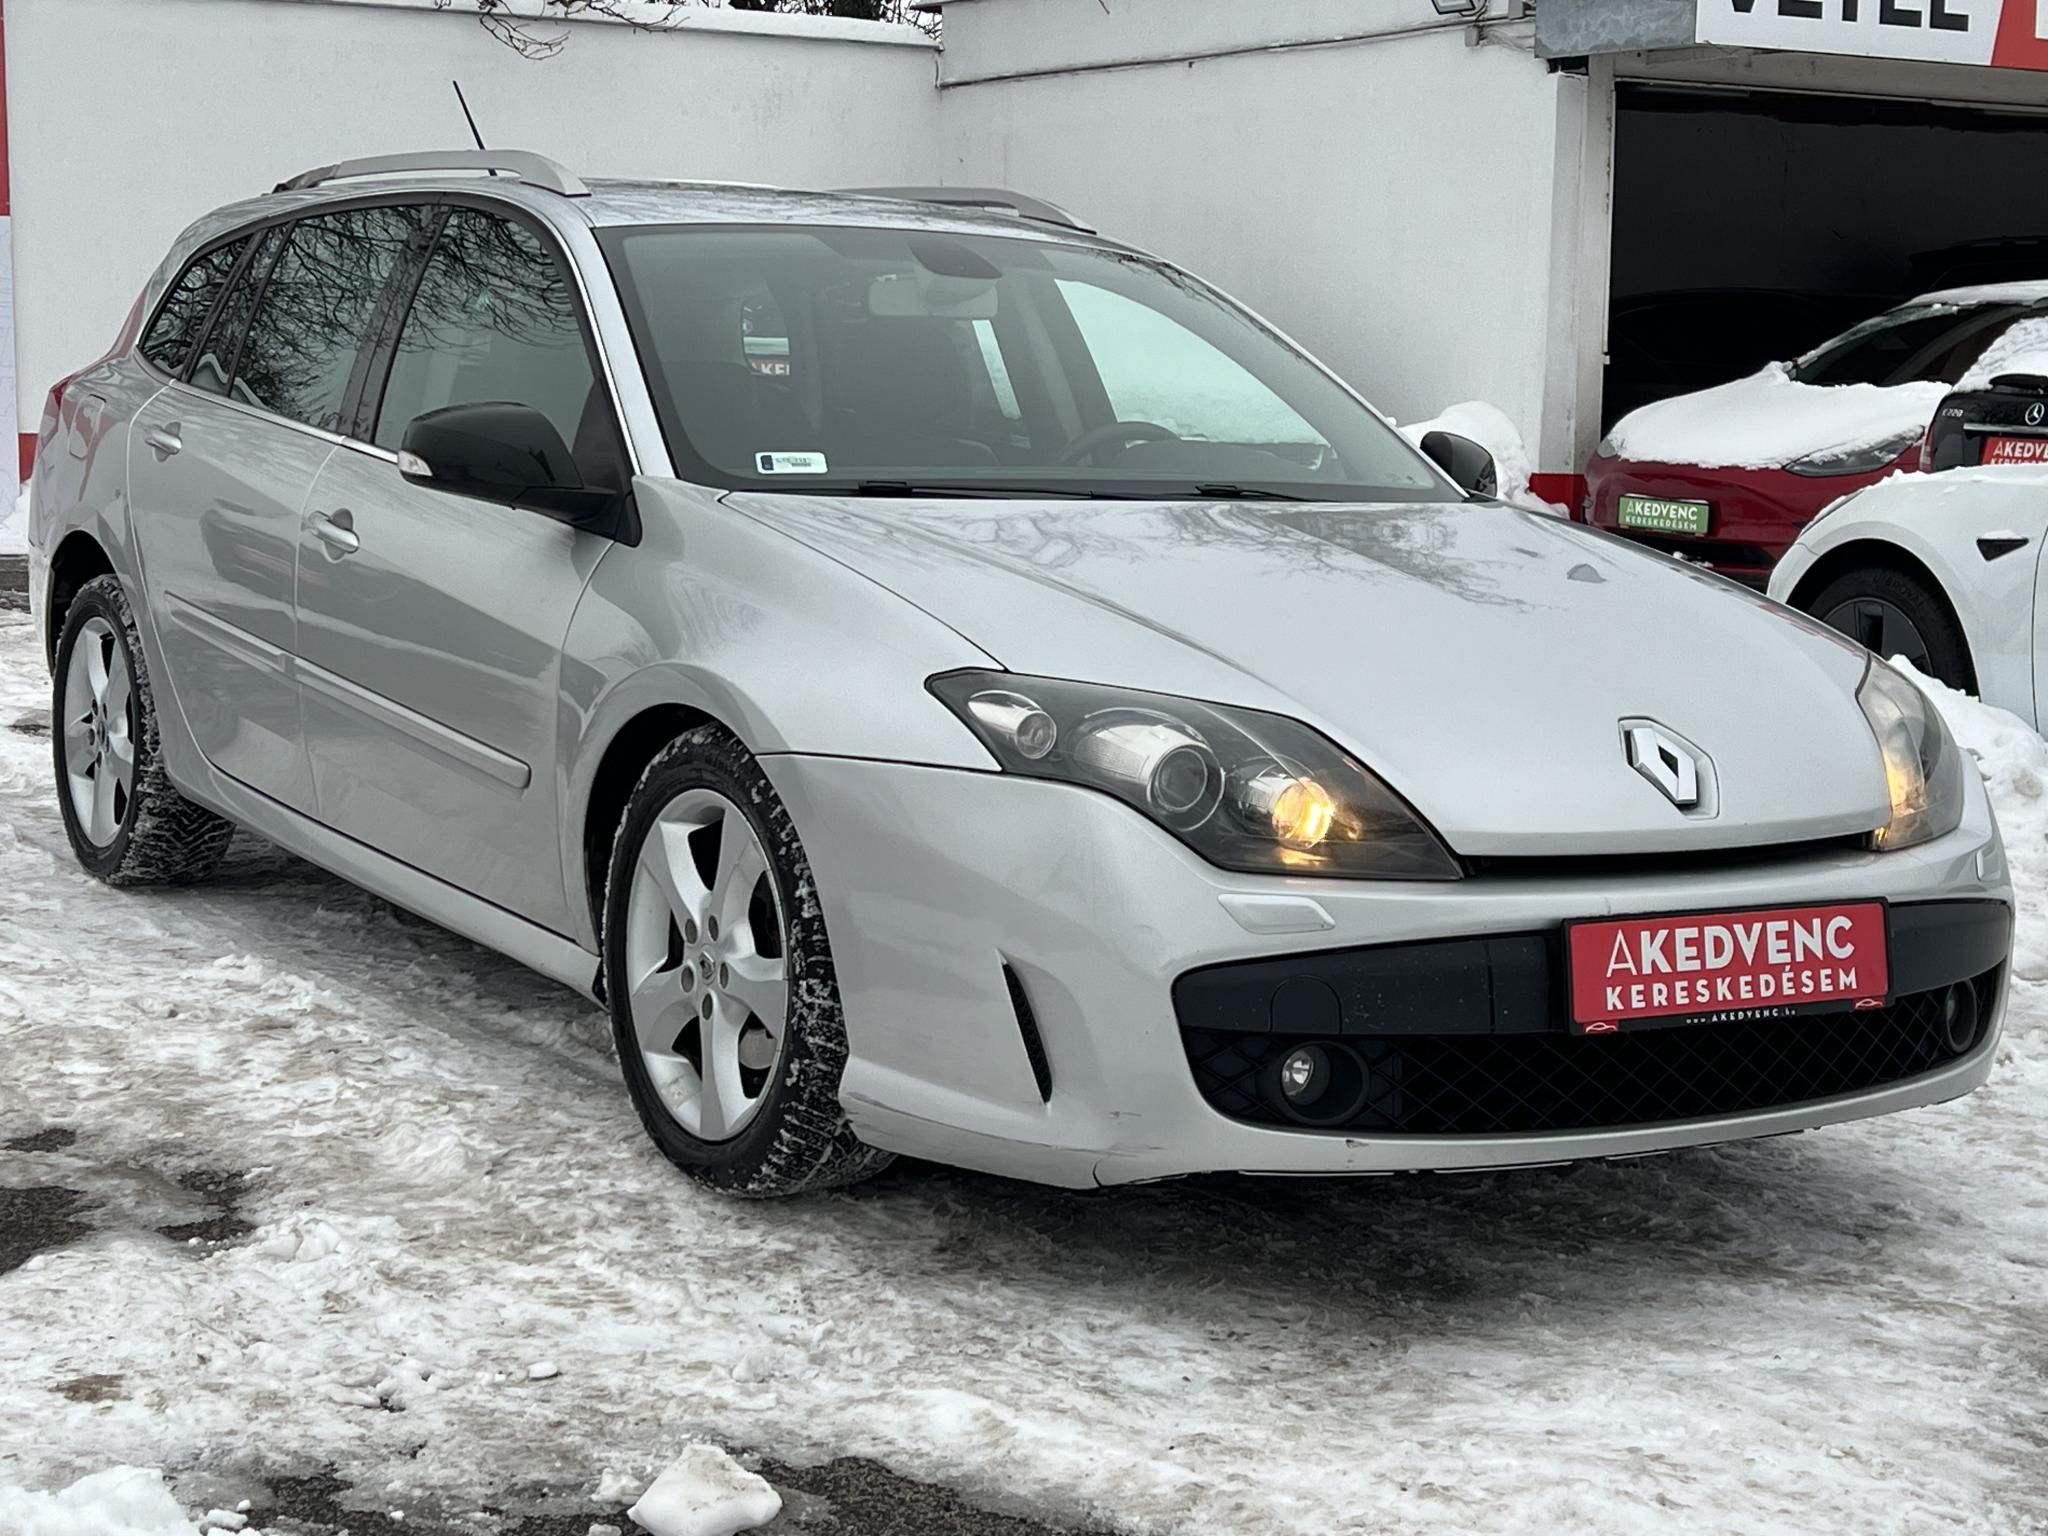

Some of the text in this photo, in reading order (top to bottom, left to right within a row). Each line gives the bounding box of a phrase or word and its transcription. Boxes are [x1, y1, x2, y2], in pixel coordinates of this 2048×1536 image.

[1625, 515, 1697, 531] KERESKEDÉSEM
[1626, 500, 1698, 521] AKEDVENC
[1605, 915, 1856, 978] AKEDVENC
[1605, 965, 1858, 1012] KERESKEDÉSEM
